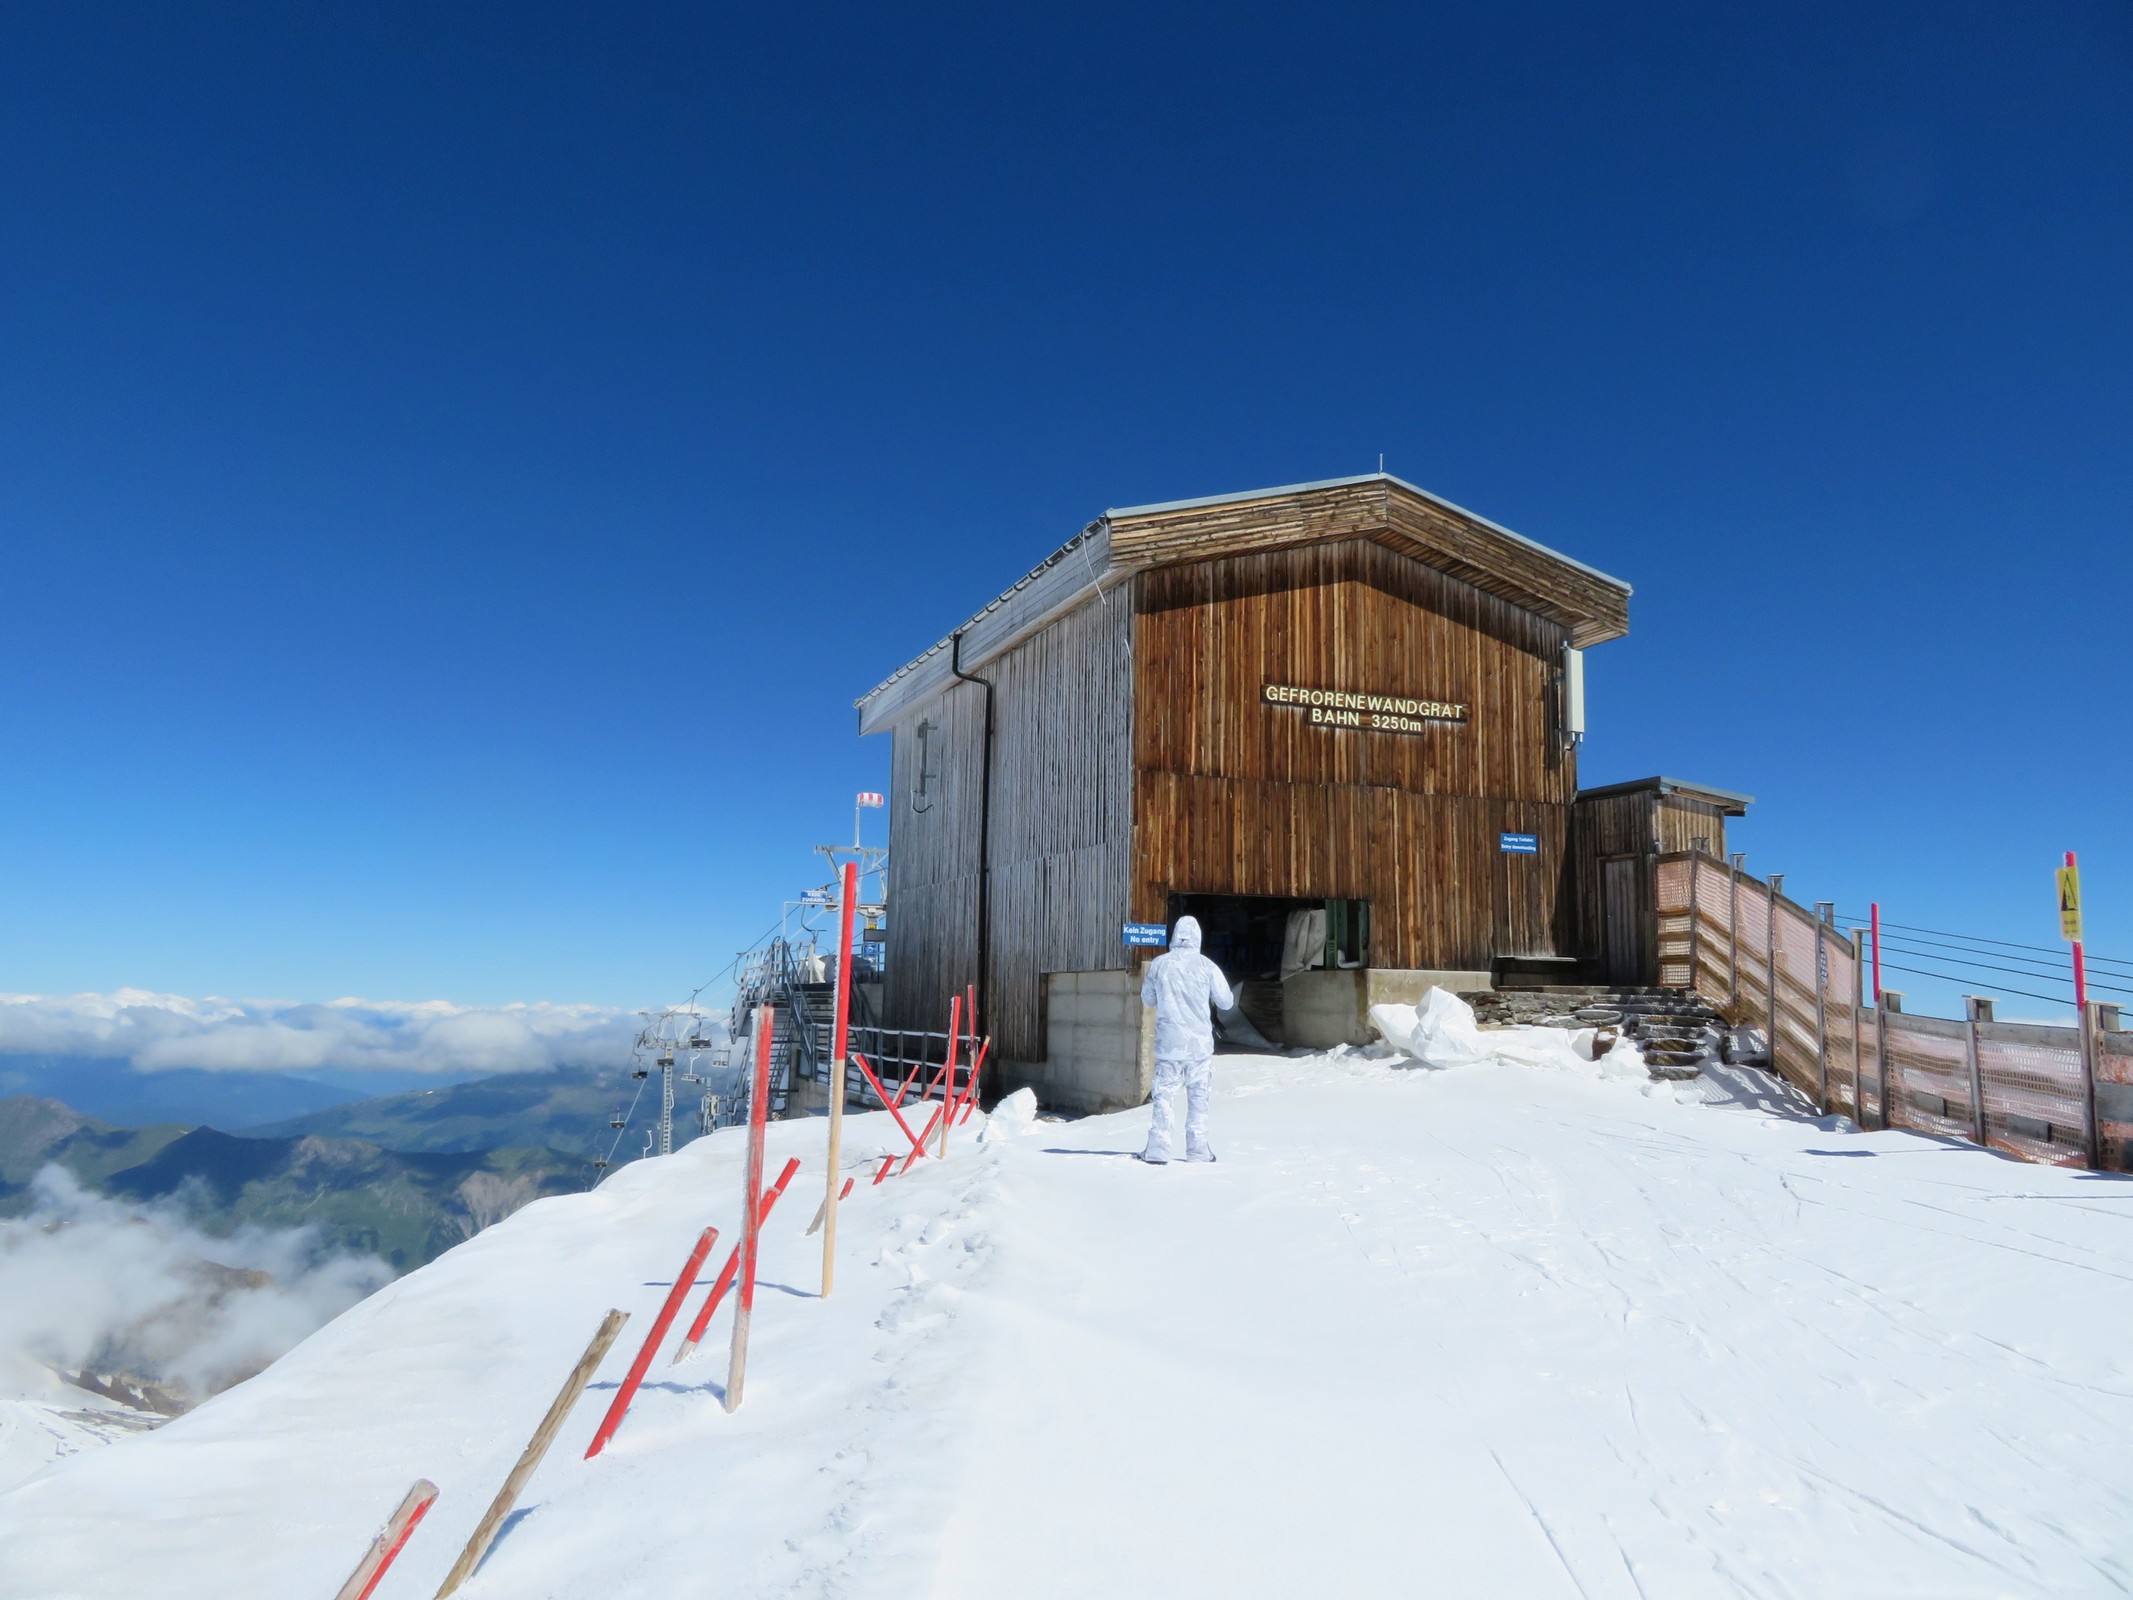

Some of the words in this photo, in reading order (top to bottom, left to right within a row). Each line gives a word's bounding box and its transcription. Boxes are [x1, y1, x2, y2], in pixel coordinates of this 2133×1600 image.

[1265, 686, 1463, 718] GEFRORENEWANDGRAT
[1312, 708, 1360, 726] BAHN
[1371, 714, 1422, 732] 3250m
[1123, 926, 1139, 934] Kein
[1140, 926, 1166, 936] Zugang
[1141, 937, 1159, 945] entry
